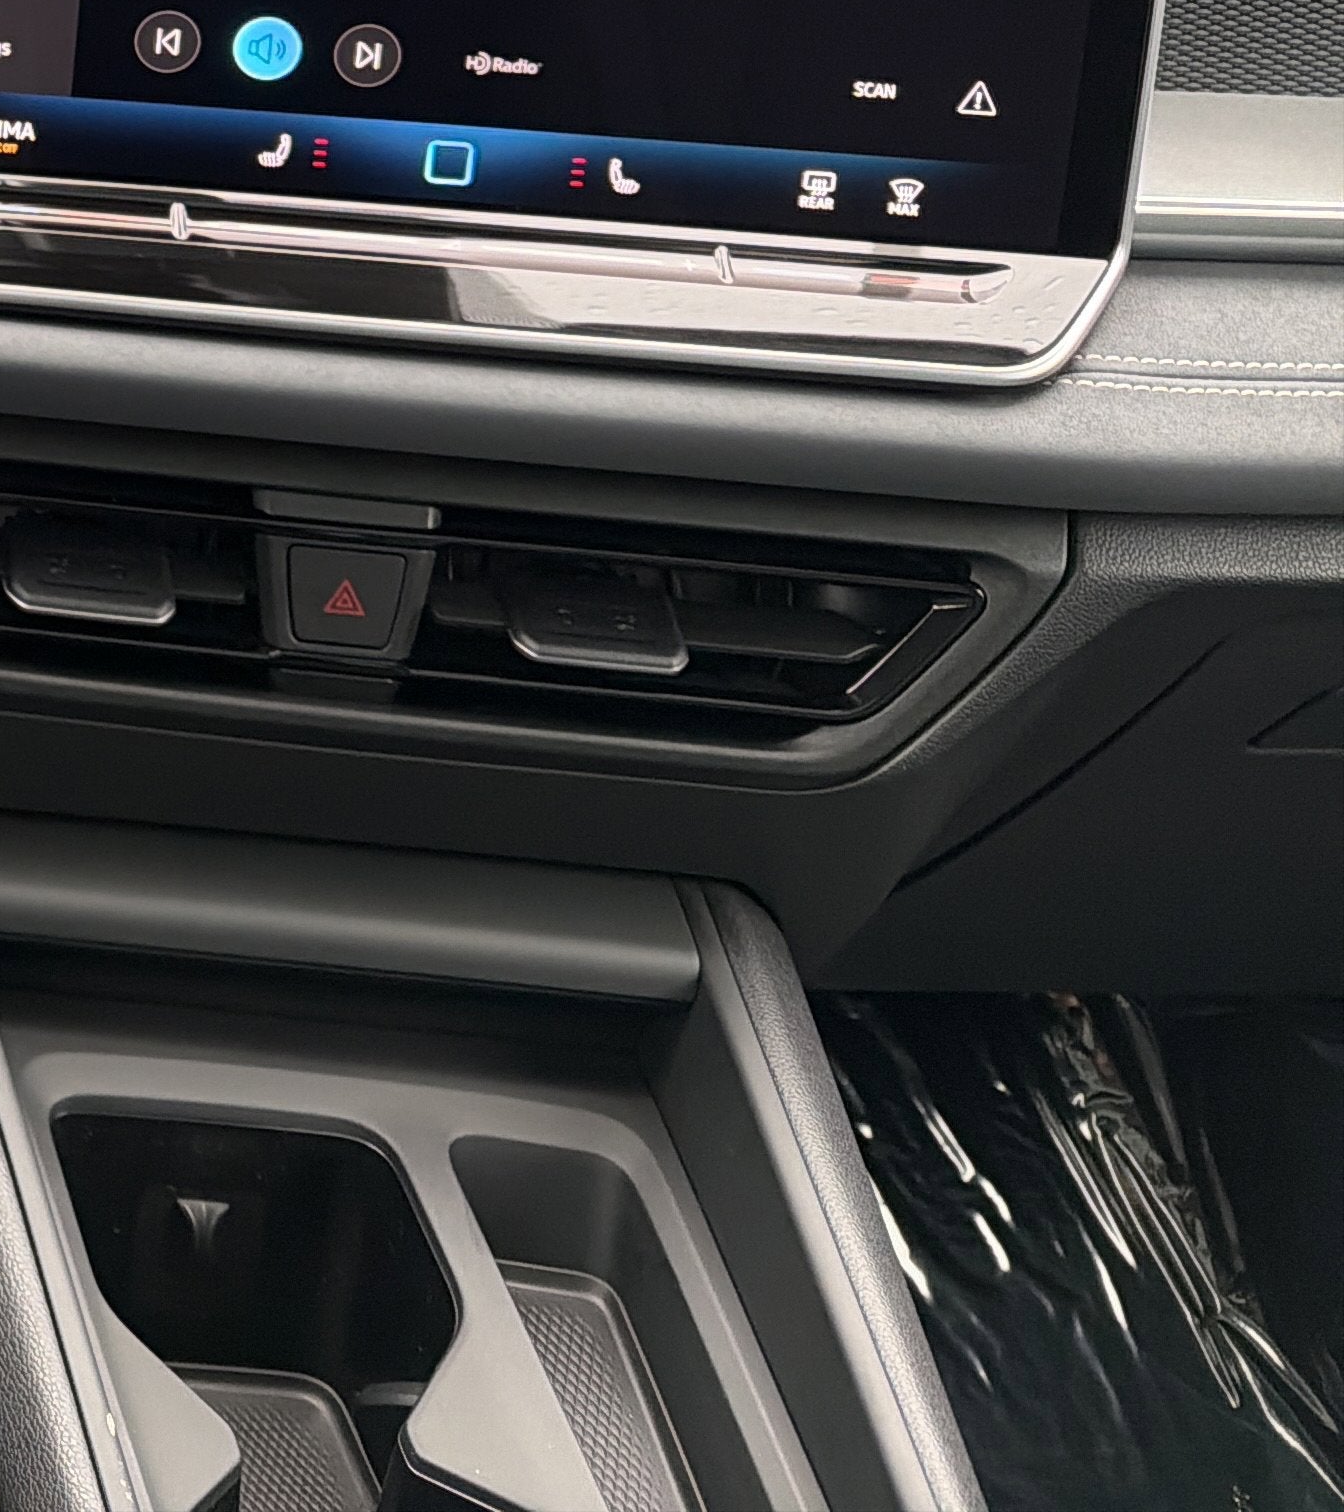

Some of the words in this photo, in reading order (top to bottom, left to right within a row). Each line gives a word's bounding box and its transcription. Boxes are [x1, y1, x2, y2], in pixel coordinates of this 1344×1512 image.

[853, 80, 897, 100] SCAN
[797, 194, 835, 210] REAR
[887, 201, 921, 217] MAX
